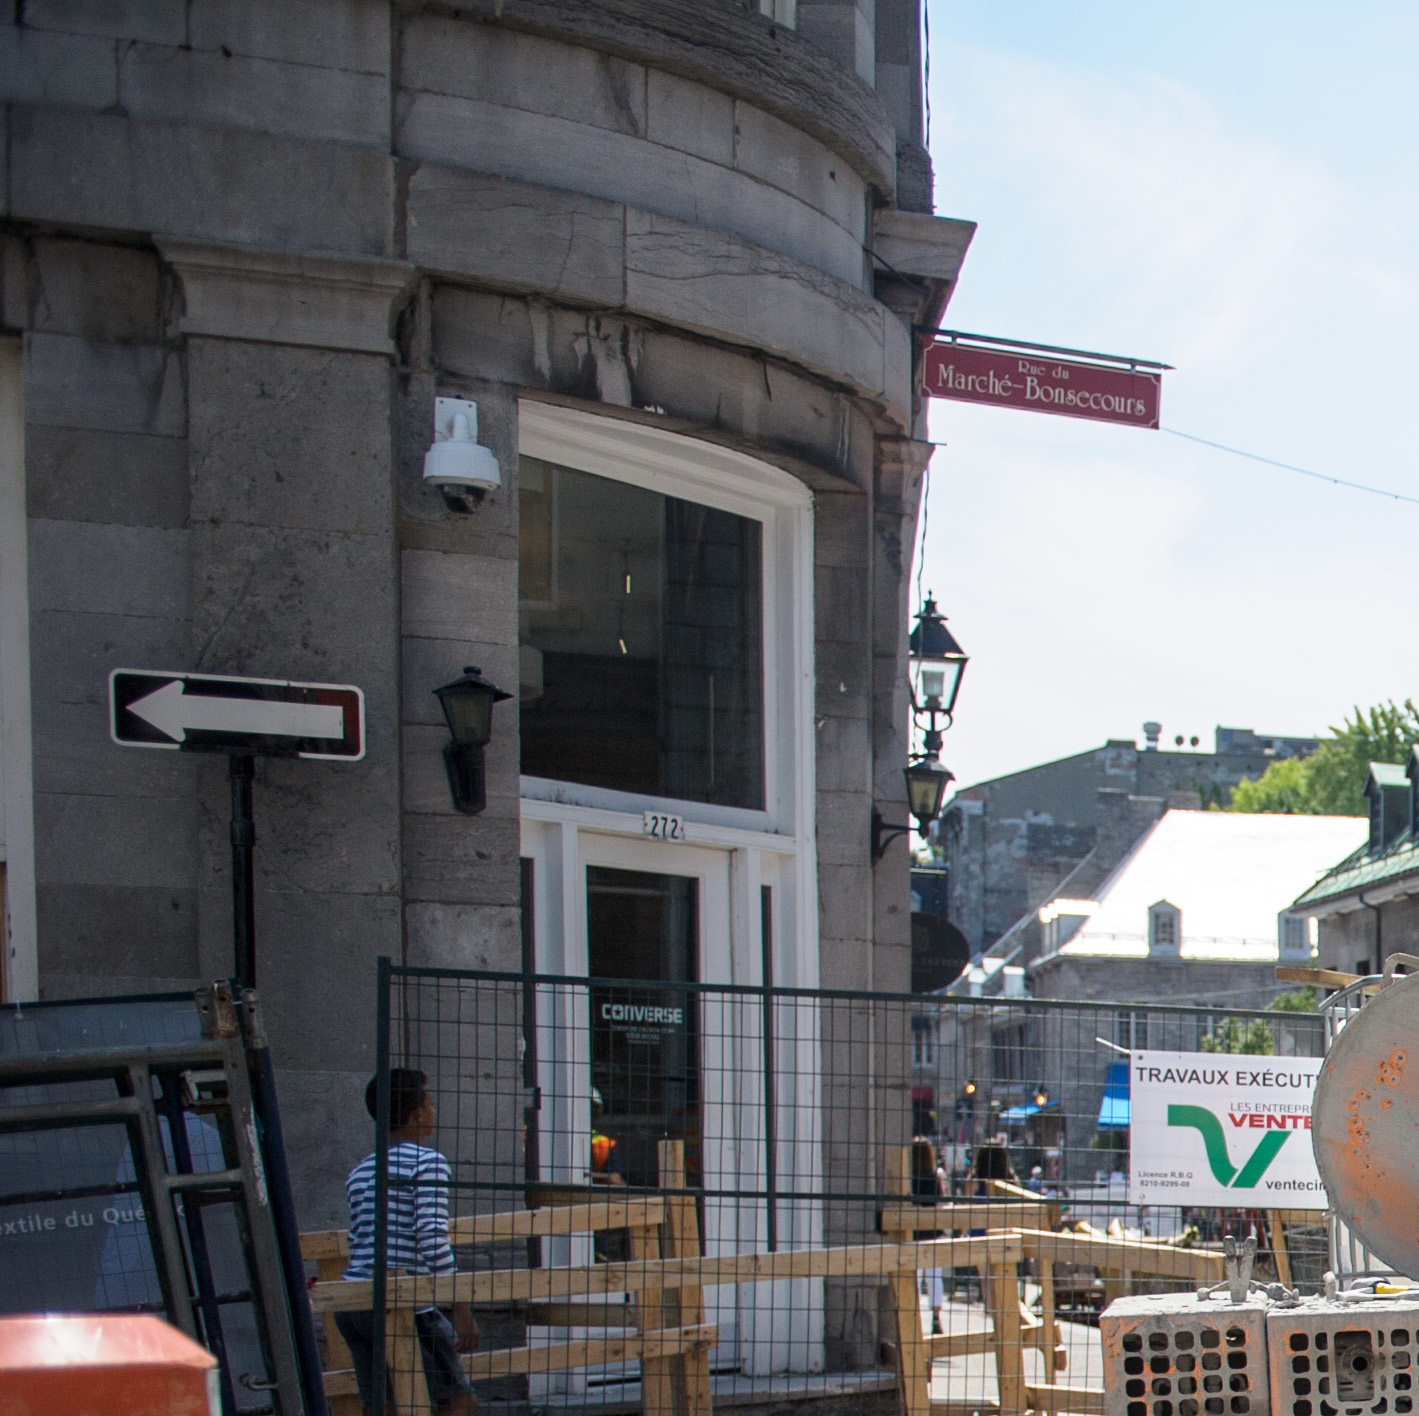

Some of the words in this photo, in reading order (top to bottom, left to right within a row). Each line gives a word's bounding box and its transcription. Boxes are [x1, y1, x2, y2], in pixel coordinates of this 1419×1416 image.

[1018, 360, 1046, 376] Rue
[1052, 364, 1070, 380] du
[938, 363, 1146, 416] Marché-Bonsecours
[651, 815, 680, 839] 272
[602, 1003, 684, 1024] CONVERSE
[1136, 1067, 1229, 1085] TRAVAUX
[1236, 1069, 1319, 1089] EXÉCUT
[1230, 1102, 1251, 1112] LES
[1138, 1170, 1168, 1179] Licence
[0, 1214, 57, 1235] xtile
[65, 1210, 94, 1228] du
